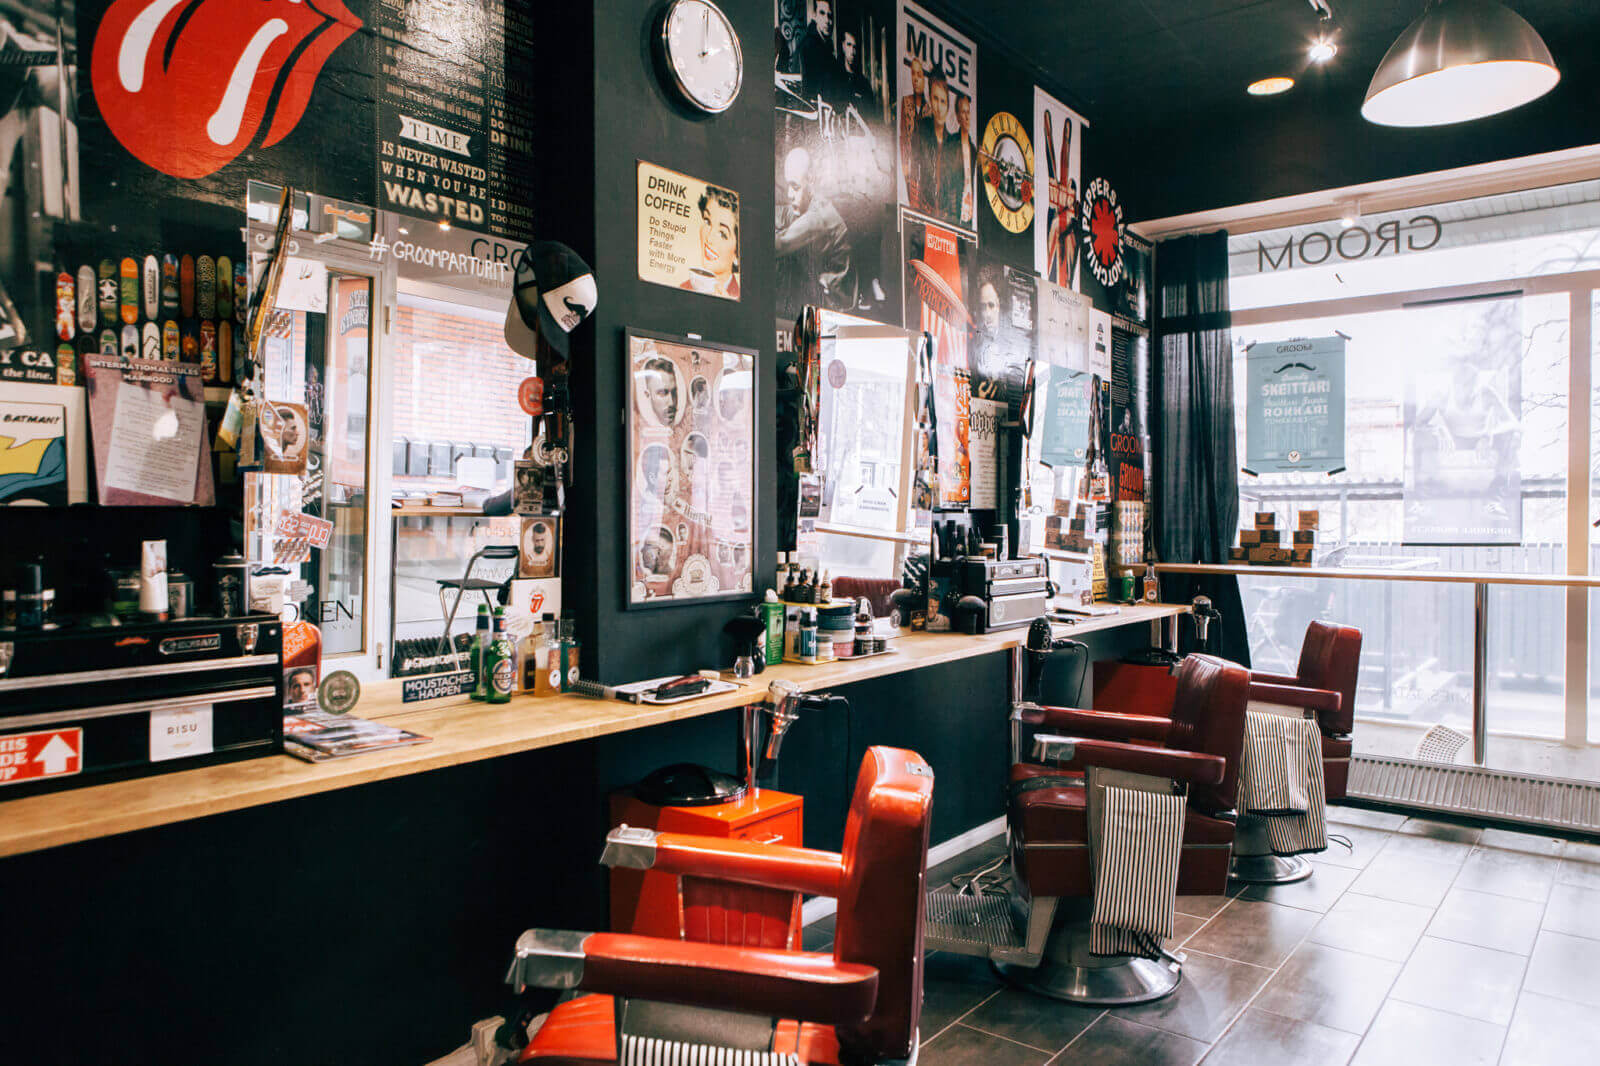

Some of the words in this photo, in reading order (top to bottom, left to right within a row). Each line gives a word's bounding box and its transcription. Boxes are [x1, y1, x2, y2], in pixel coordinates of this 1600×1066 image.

[905, 22, 970, 88] MUSE
[409, 121, 462, 151] TIME
[382, 140, 394, 156] IS
[396, 146, 438, 169] NEVER
[439, 157, 486, 182] WASTED
[381, 161, 427, 184] WHEN
[432, 174, 487, 200] YOU'RE
[647, 176, 687, 199] DRINK
[383, 180, 484, 225] WASTED
[644, 193, 690, 218] COFFEE
[1082, 177, 1117, 232] PEPPERS
[649, 216, 660, 226] Do
[662, 219, 687, 233] Stupid
[649, 226, 674, 241] Things
[649, 237, 673, 250] Faster
[1084, 235, 1108, 286] CHILI
[1108, 254, 1123, 286] HOT
[3, 368, 24, 379] the
[89, 360, 169, 374] INTERNATIONAL
[170, 366, 199, 376] RULES
[124, 374, 173, 384] MANHOOD
[1261, 379, 1330, 397] SKEITTARI
[3, 413, 61, 425] BATMAN!
[405, 672, 475, 692] MOUSTACHES
[418, 685, 462, 699] HAPPEN
[167, 723, 198, 735] RISU
